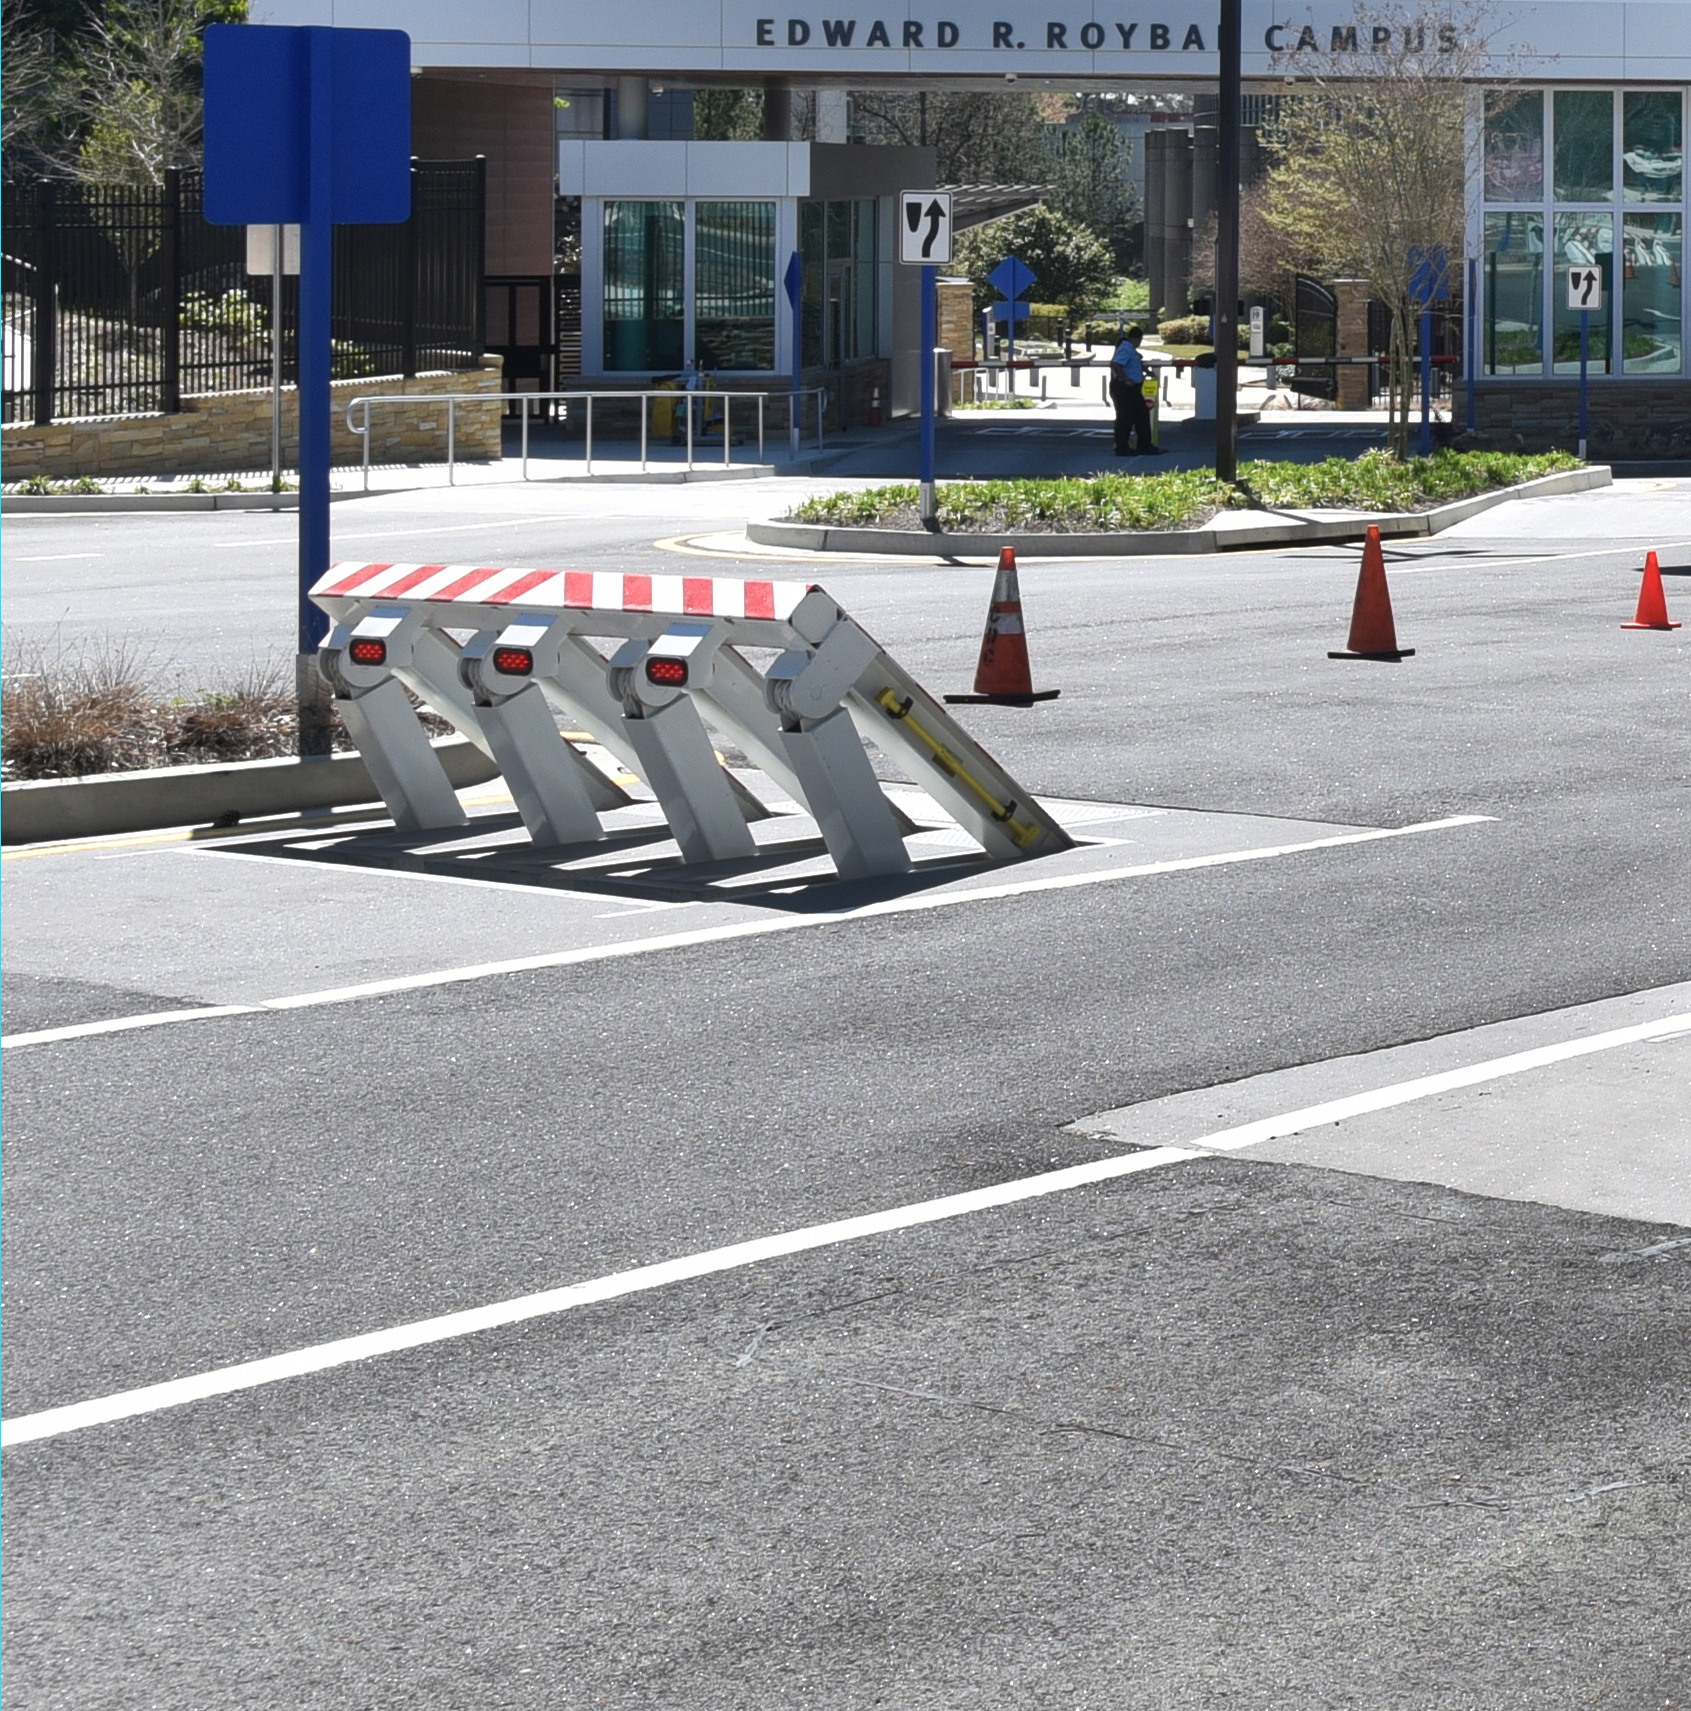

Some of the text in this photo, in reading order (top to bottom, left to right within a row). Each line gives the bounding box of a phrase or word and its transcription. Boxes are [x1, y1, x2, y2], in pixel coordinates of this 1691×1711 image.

[756, 18, 1457, 53] EDWARD R. ROYBA CAMPUS
